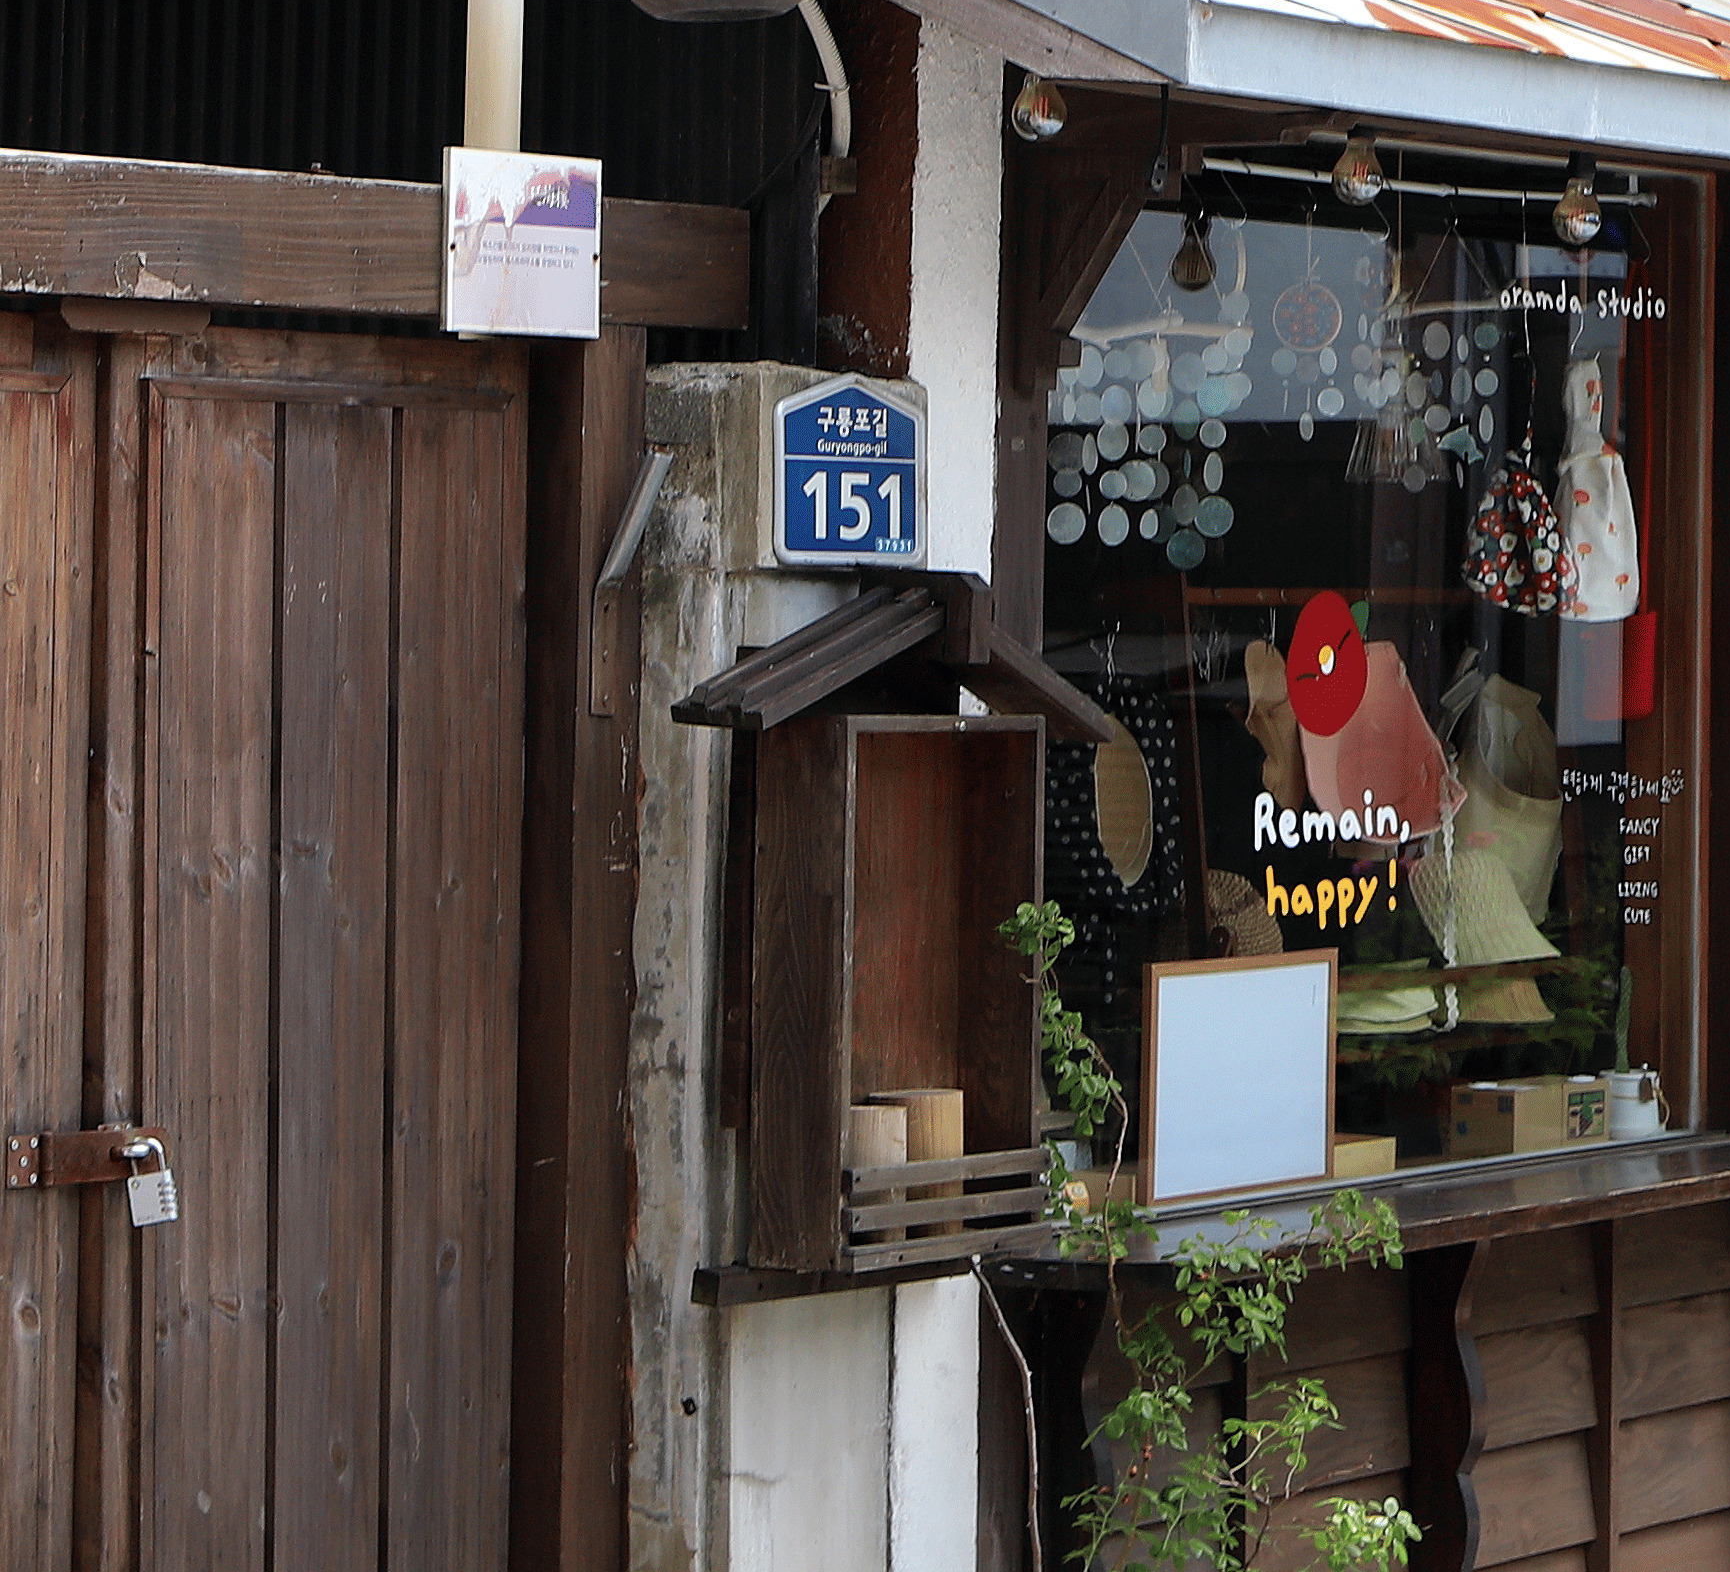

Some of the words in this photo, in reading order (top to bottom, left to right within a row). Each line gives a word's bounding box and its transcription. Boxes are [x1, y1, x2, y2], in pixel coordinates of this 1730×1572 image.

[817, 406, 888, 439] 구룡포길
[817, 437, 888, 458] Guryongpo-gil
[802, 471, 901, 541] 151
[1254, 789, 1410, 852] Remain,
[1619, 817, 1660, 838] FANCY
[1624, 845, 1651, 865] GIFT
[1618, 881, 1659, 898] LIVING
[1624, 906, 1652, 925] CUTE
